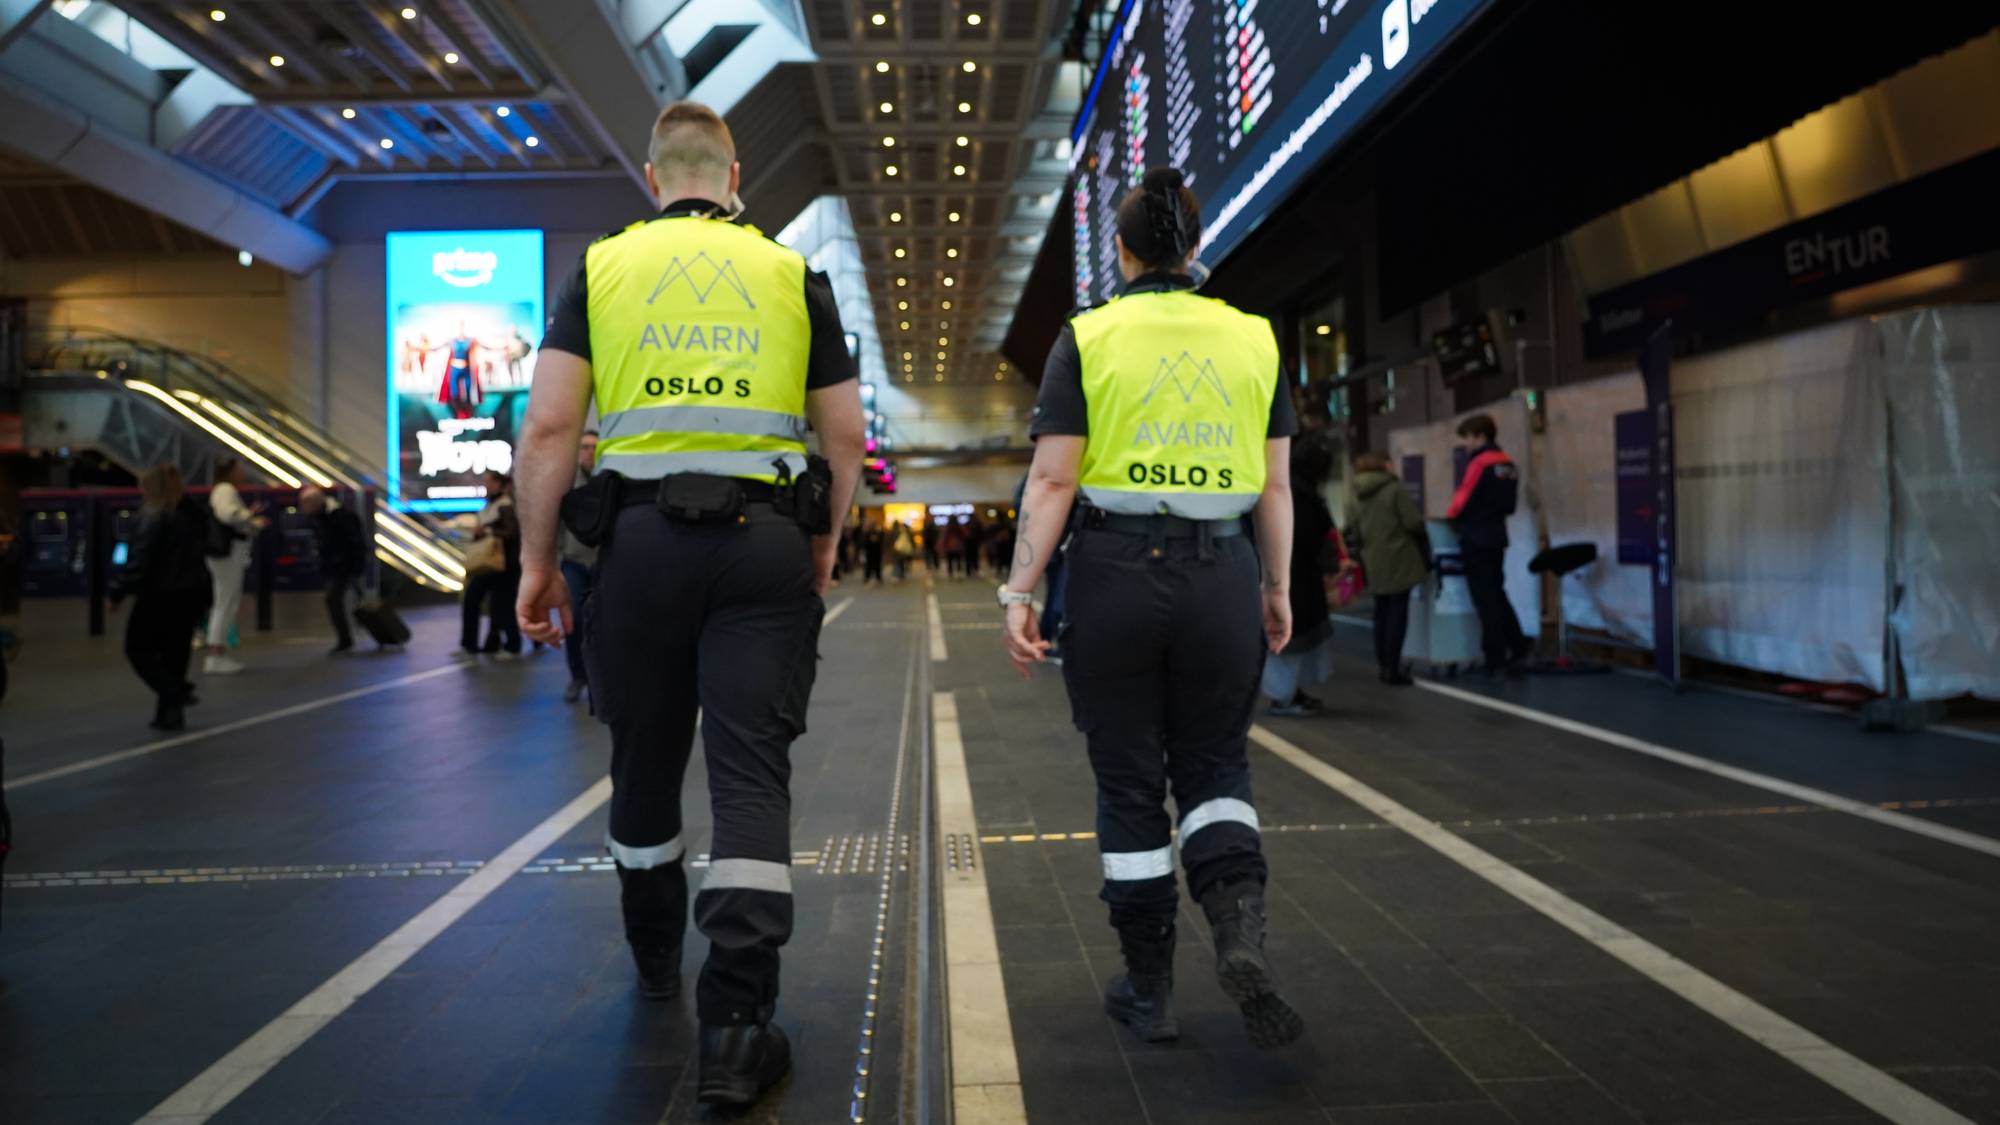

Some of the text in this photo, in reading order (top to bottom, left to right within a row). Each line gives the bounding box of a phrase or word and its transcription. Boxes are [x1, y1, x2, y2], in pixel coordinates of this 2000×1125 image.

[1784, 225, 1891, 275] ENTUR
[638, 323, 760, 355] AVARN
[645, 377, 750, 397] OSLO S
[1132, 421, 1233, 448] AVARN
[1128, 462, 1233, 488] OSLO S
